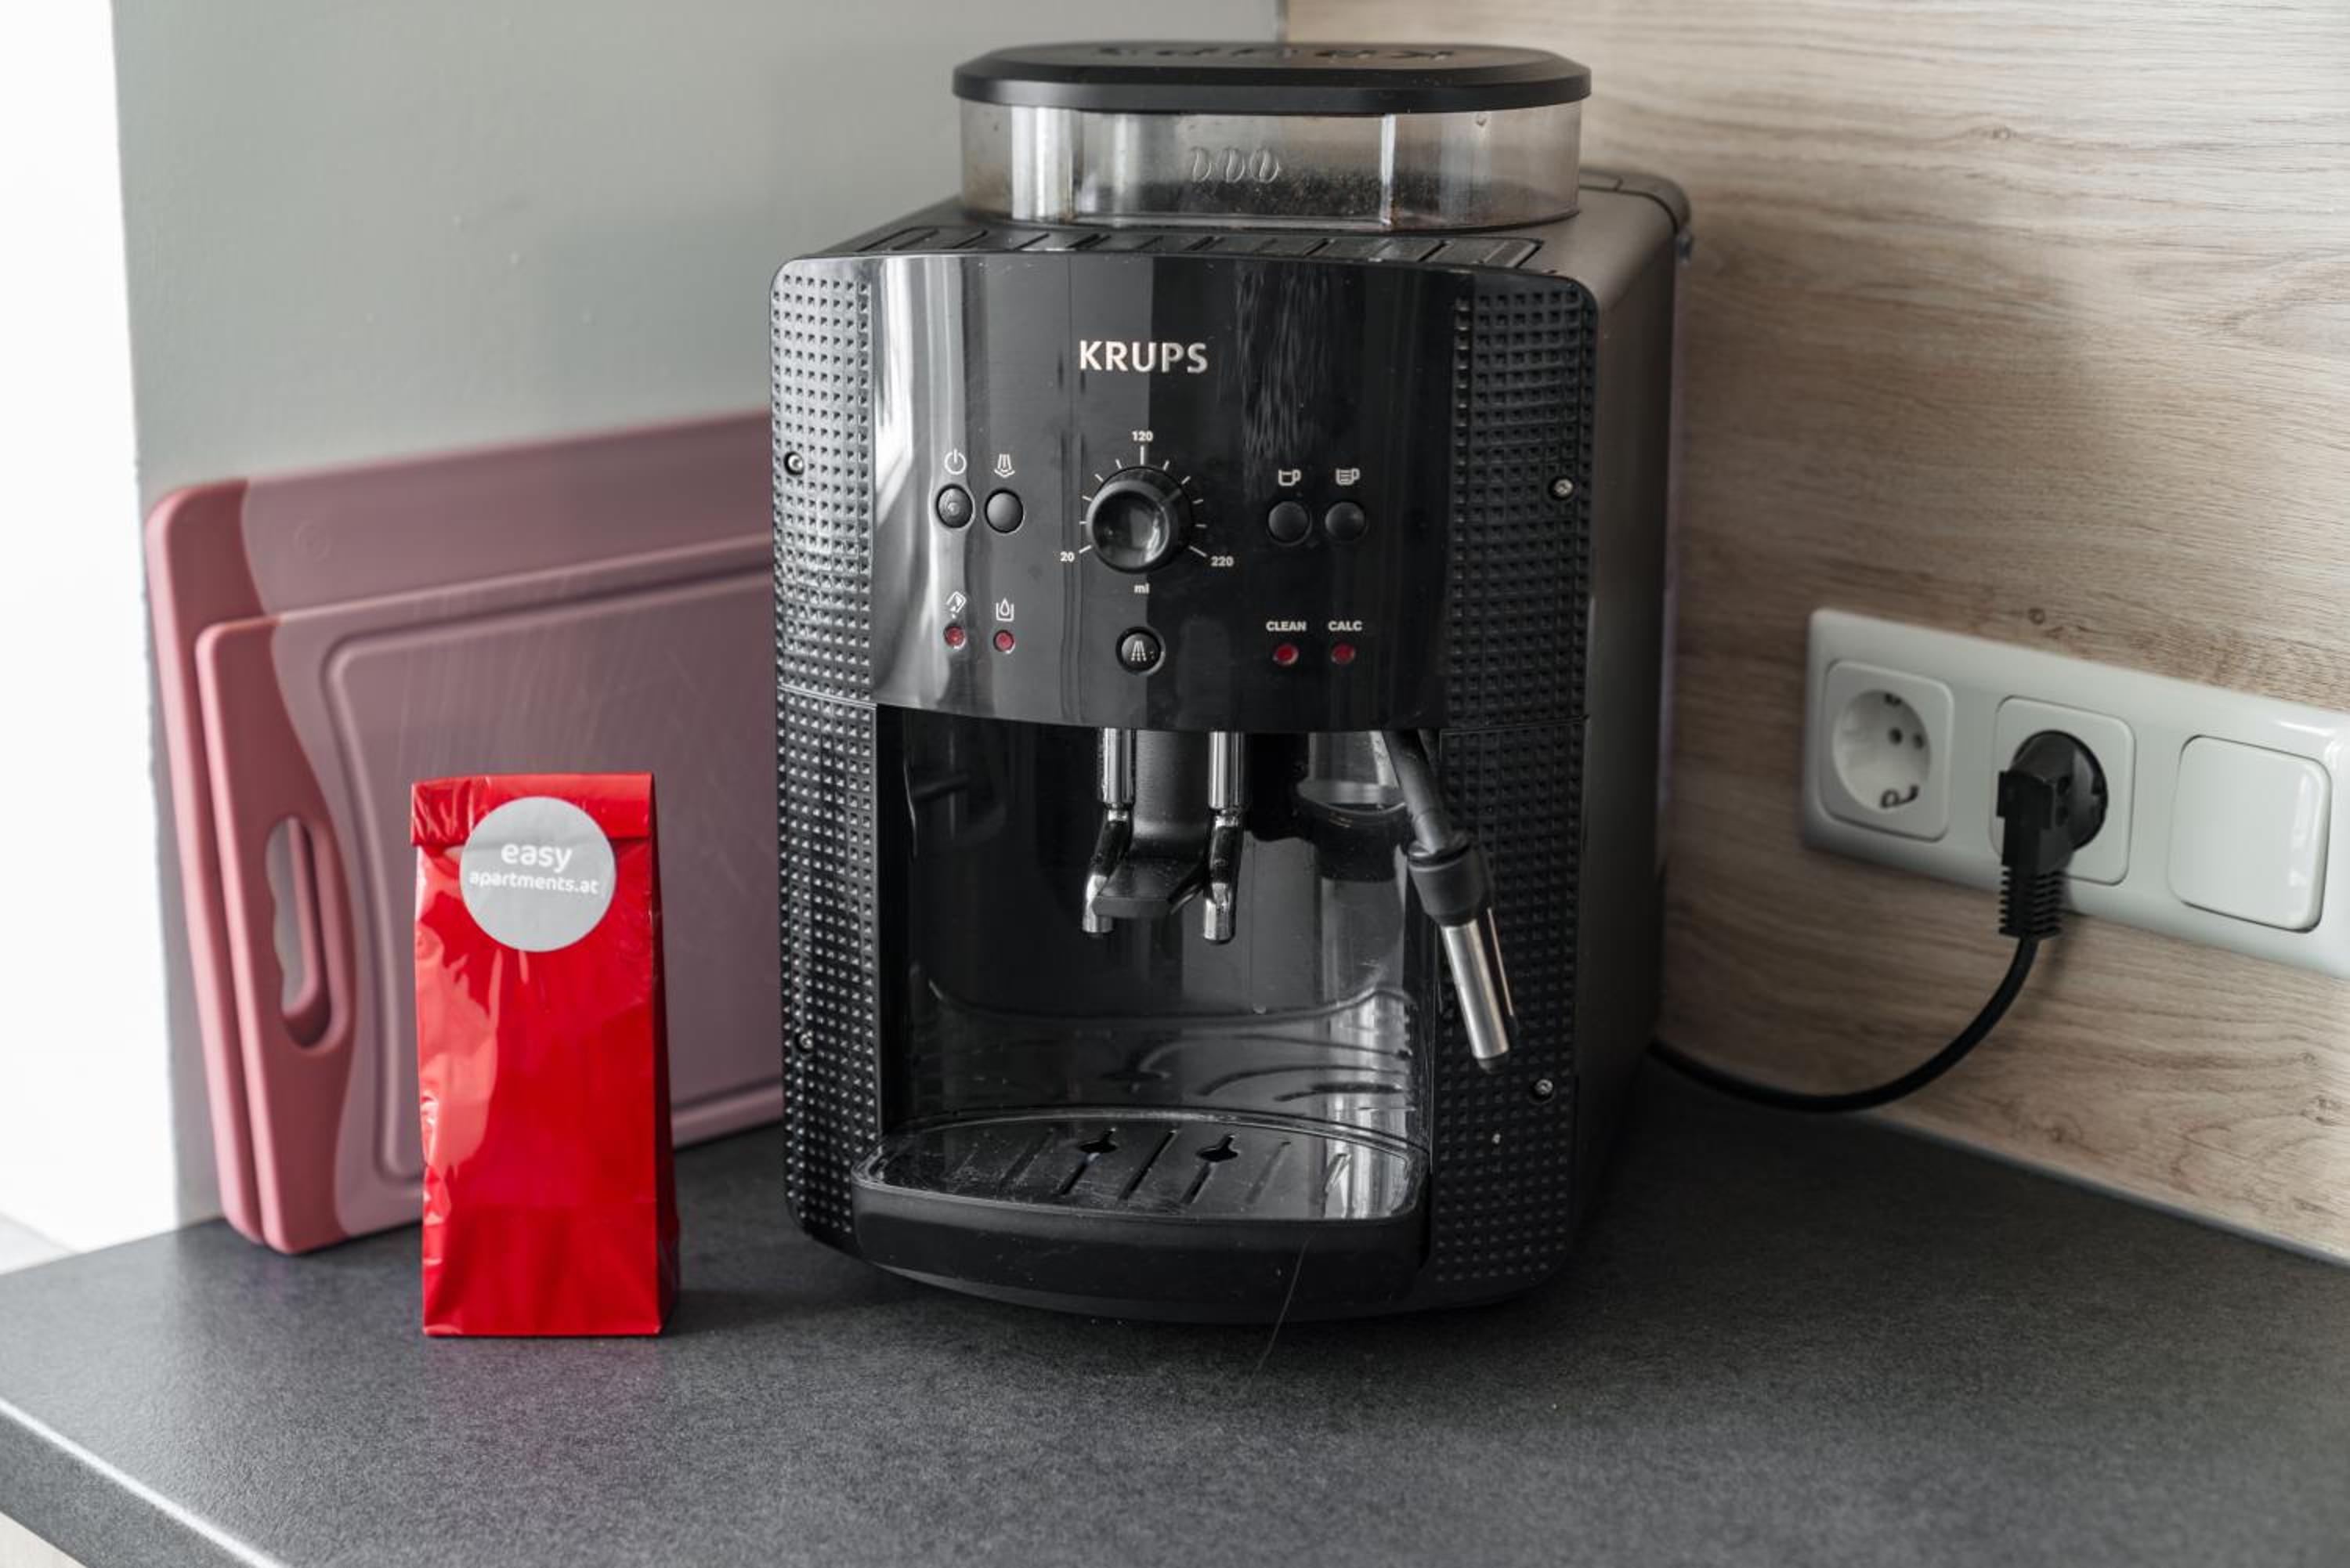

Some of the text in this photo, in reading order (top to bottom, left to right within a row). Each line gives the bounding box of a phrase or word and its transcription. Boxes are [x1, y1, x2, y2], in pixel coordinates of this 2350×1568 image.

[1079, 341, 1208, 373] KRUPS
[1132, 430, 1154, 443] 120
[1060, 551, 1075, 562] 20
[1210, 555, 1235, 567] 220
[1133, 583, 1149, 594] ml
[1266, 620, 1306, 631] CLEAN
[1329, 620, 1362, 631] CALC
[501, 843, 573, 873] easy
[469, 870, 600, 894] apartments.at
